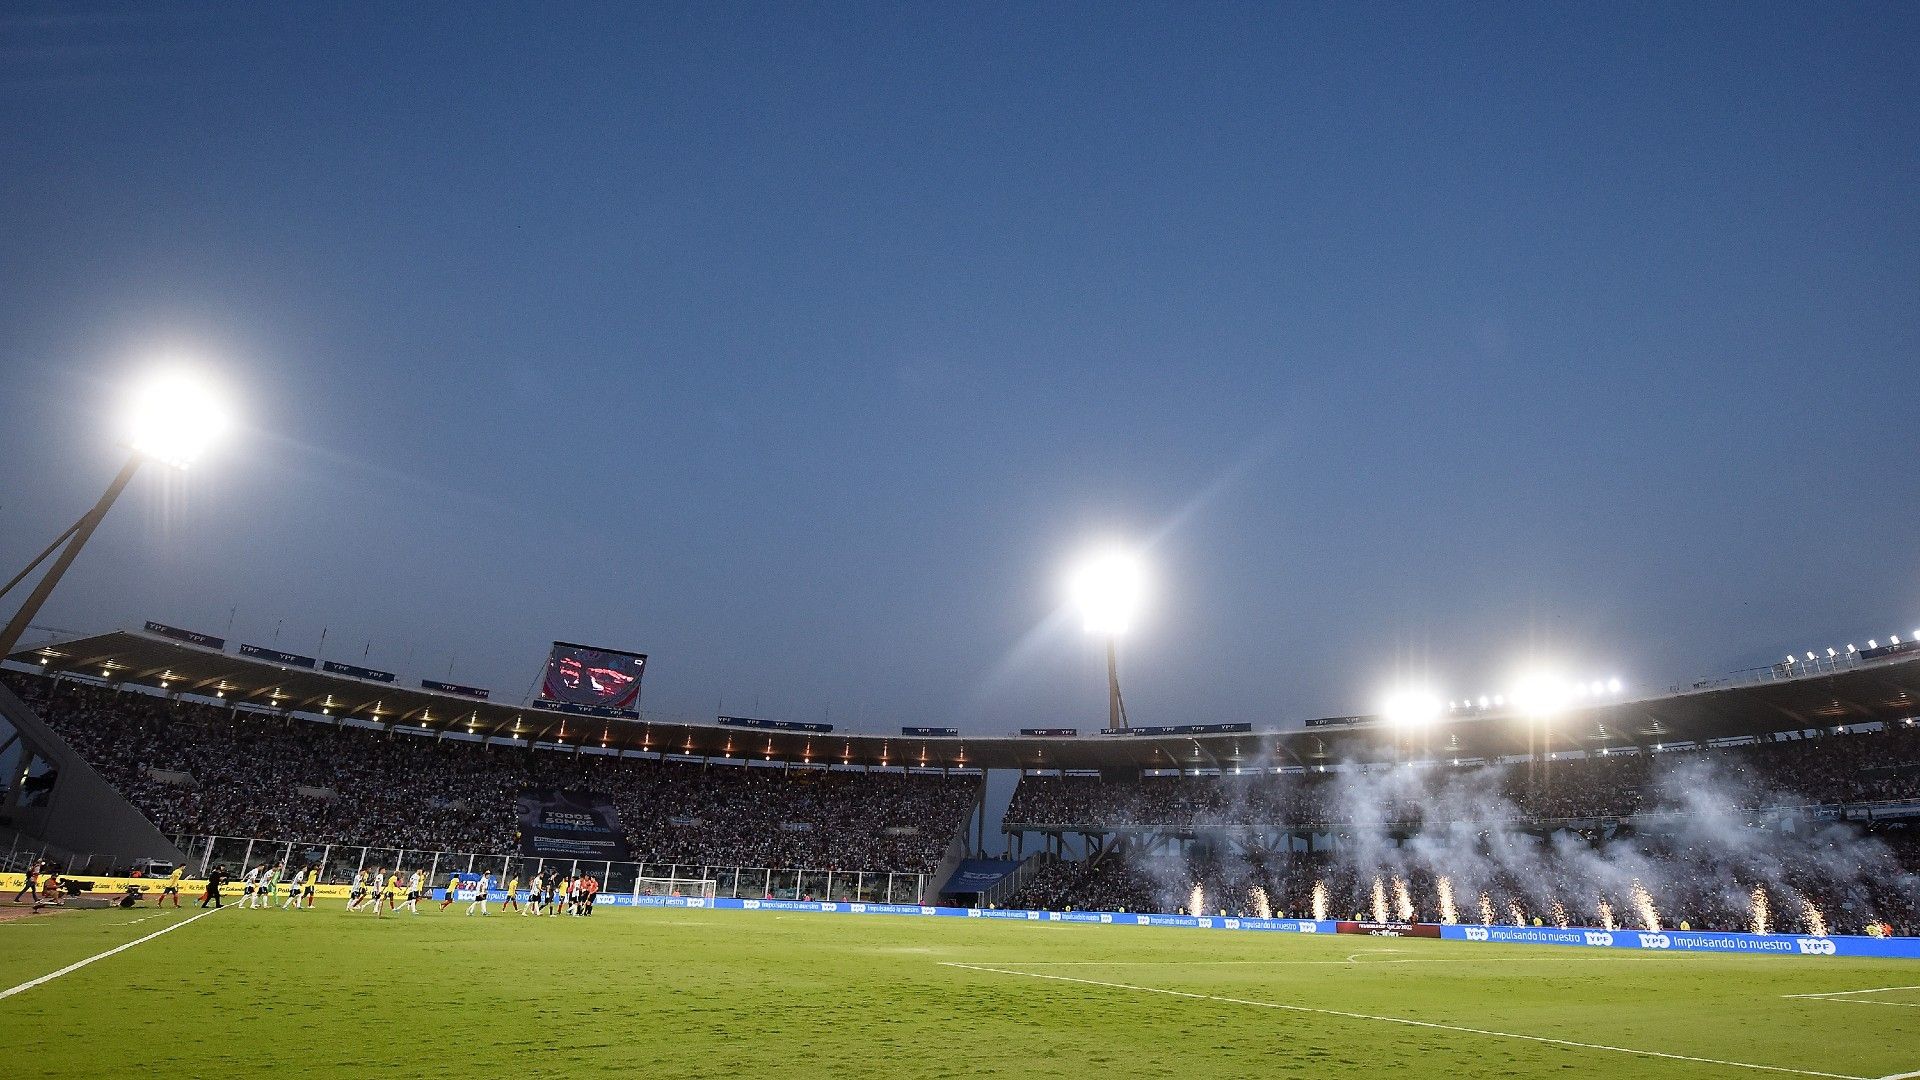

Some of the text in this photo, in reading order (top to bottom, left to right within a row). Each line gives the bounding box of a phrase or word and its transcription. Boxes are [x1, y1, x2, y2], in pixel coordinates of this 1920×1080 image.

[150, 623, 206, 642] YPF YPF
[242, 645, 296, 662] YPF YPF
[546, 812, 592, 820] TODOS
[546, 818, 594, 826] SOMOS
[762, 901, 792, 909] Impulsando
[1242, 921, 1270, 929] Impulsando
[1492, 930, 1537, 940] Impulsando
[1539, 932, 1547, 941] lo
[1549, 934, 1580, 942] nuestro
[1674, 936, 1735, 949] Impulsando
[1736, 938, 1747, 949] lo
[1750, 940, 1792, 950] nuestro
